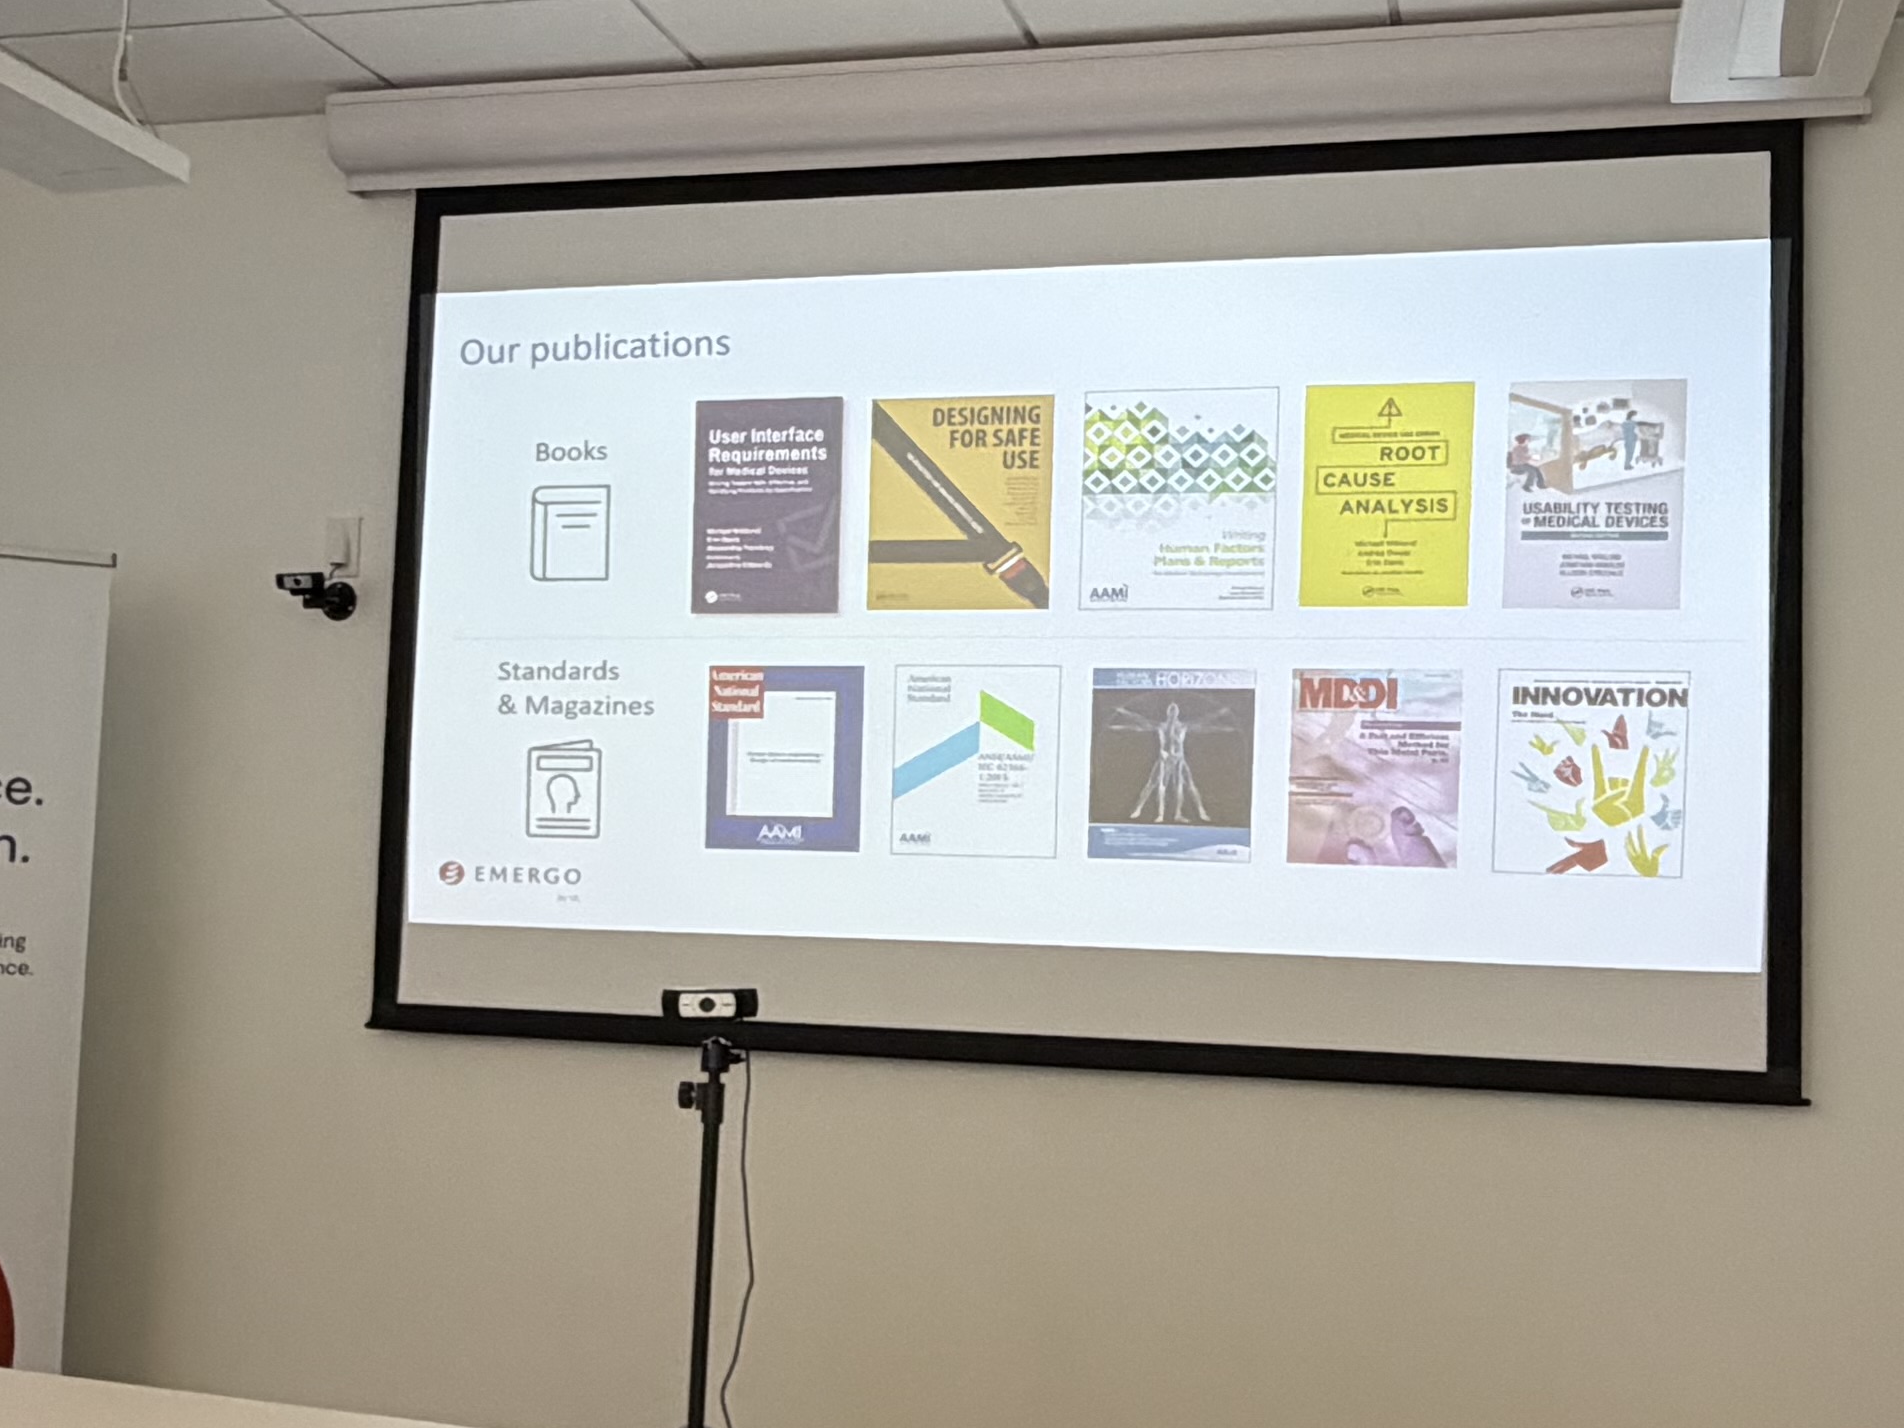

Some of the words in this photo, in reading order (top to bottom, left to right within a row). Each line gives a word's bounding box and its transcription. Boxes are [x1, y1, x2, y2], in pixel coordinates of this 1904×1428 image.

[460, 338, 520, 365] Our
[531, 331, 731, 369] publications
[932, 405, 1042, 427] DESIGNING
[708, 429, 747, 444] User
[750, 426, 825, 444] Interface
[949, 429, 987, 449] FOR
[992, 427, 1042, 448] SAFE
[535, 439, 609, 462] Books
[708, 445, 828, 465] Requirements
[1002, 449, 1041, 470] USE
[1379, 445, 1441, 462] ROOT
[1323, 472, 1396, 488] CAUSE
[1339, 497, 1449, 515] ANALYSIS
[1522, 502, 1600, 515] USABILITY
[1605, 502, 1669, 515] TESTING
[1533, 515, 1600, 528] MEDICAL
[1605, 516, 1669, 528] DEVICES
[1213, 542, 1265, 553] Factors
[497, 660, 620, 681] Standards
[497, 694, 517, 715] &
[525, 695, 655, 720] Magazines
[1512, 686, 1689, 708] INNOVATION
[474, 866, 582, 885] EMERGO
